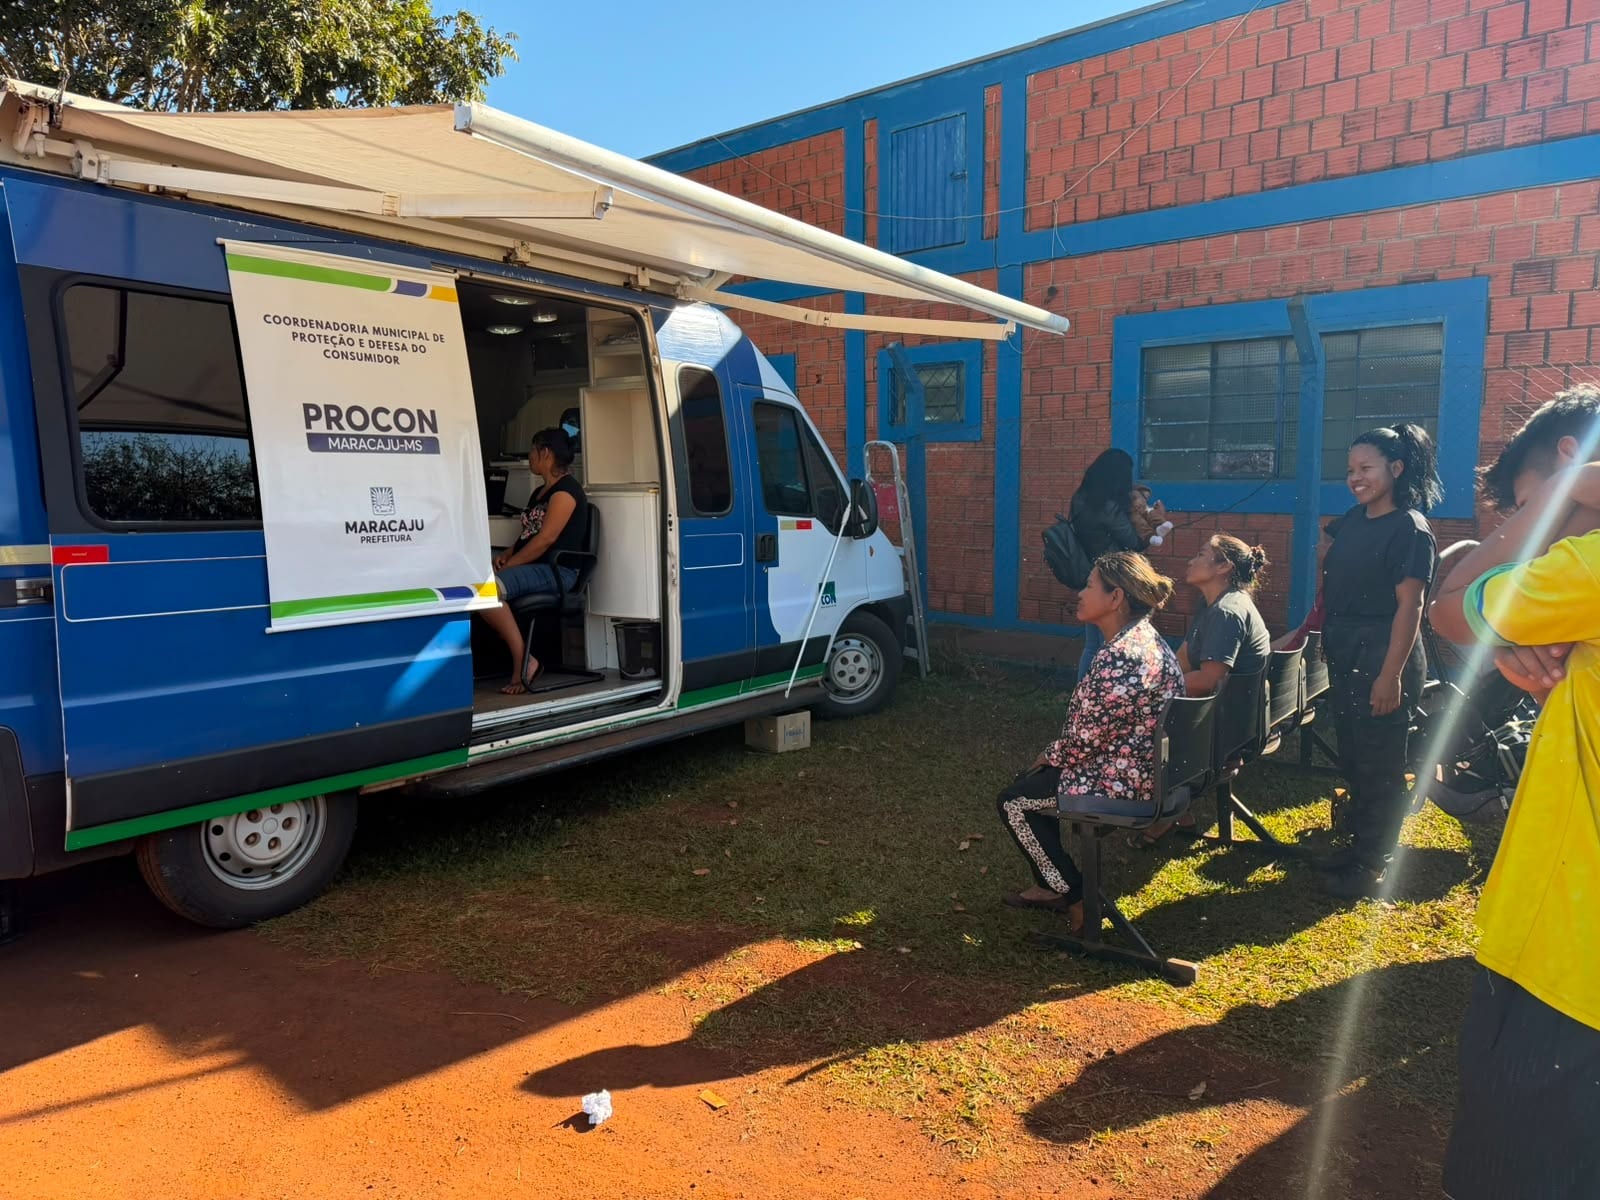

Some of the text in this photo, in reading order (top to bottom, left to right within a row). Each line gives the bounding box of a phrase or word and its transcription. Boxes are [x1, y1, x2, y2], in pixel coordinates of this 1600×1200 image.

[263, 314, 445, 343] COORDENADORIA MUNICIPAL DE
[291, 331, 427, 354] PROTEÇÃO E DEFESA DO
[323, 349, 400, 365] CONSUMIDOR
[302, 403, 438, 434] PROCON
[328, 437, 423, 451] MARACAJU-MS
[345, 519, 424, 534] MARACAJU
[360, 534, 412, 544] PREFEITURA
